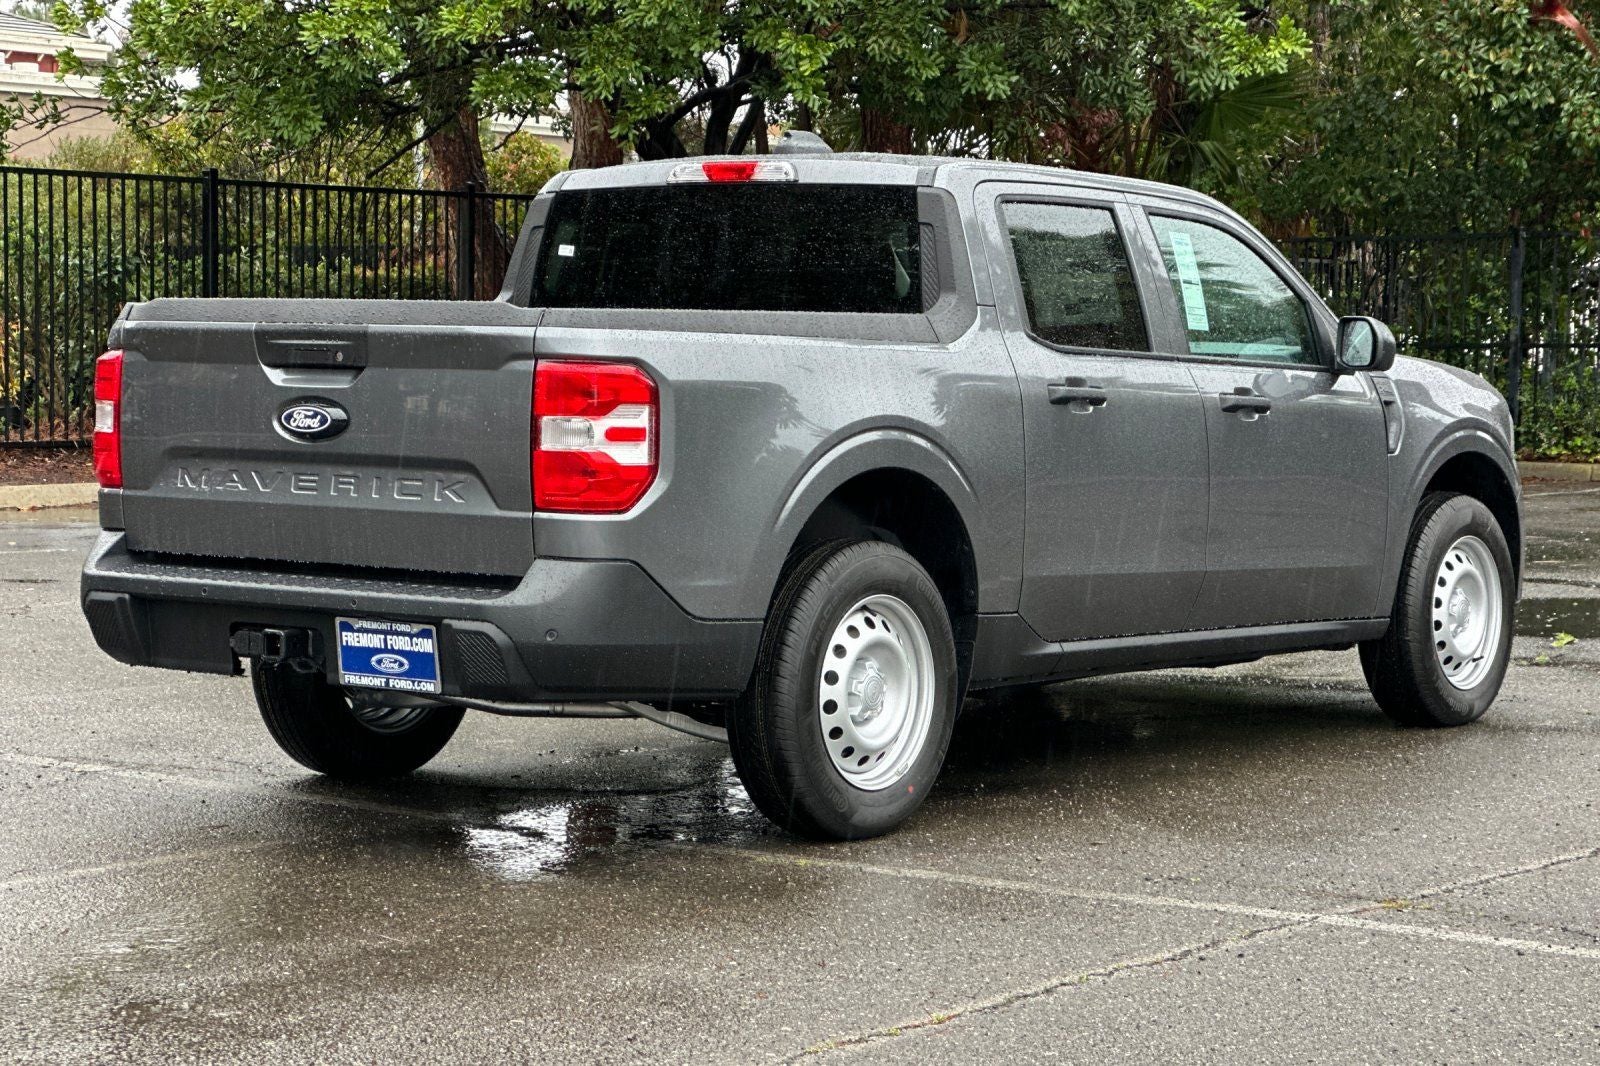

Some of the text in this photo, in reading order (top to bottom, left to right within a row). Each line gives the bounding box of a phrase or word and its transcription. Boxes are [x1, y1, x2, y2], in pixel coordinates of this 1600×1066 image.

[290, 409, 321, 427] Ford
[176, 466, 467, 503] MAVERICK
[358, 620, 411, 632] FREMONT FORD
[341, 631, 434, 654] FREMONT FORD.COM
[380, 657, 399, 669] Ford
[344, 674, 435, 692] FREMONT FORD.COM
